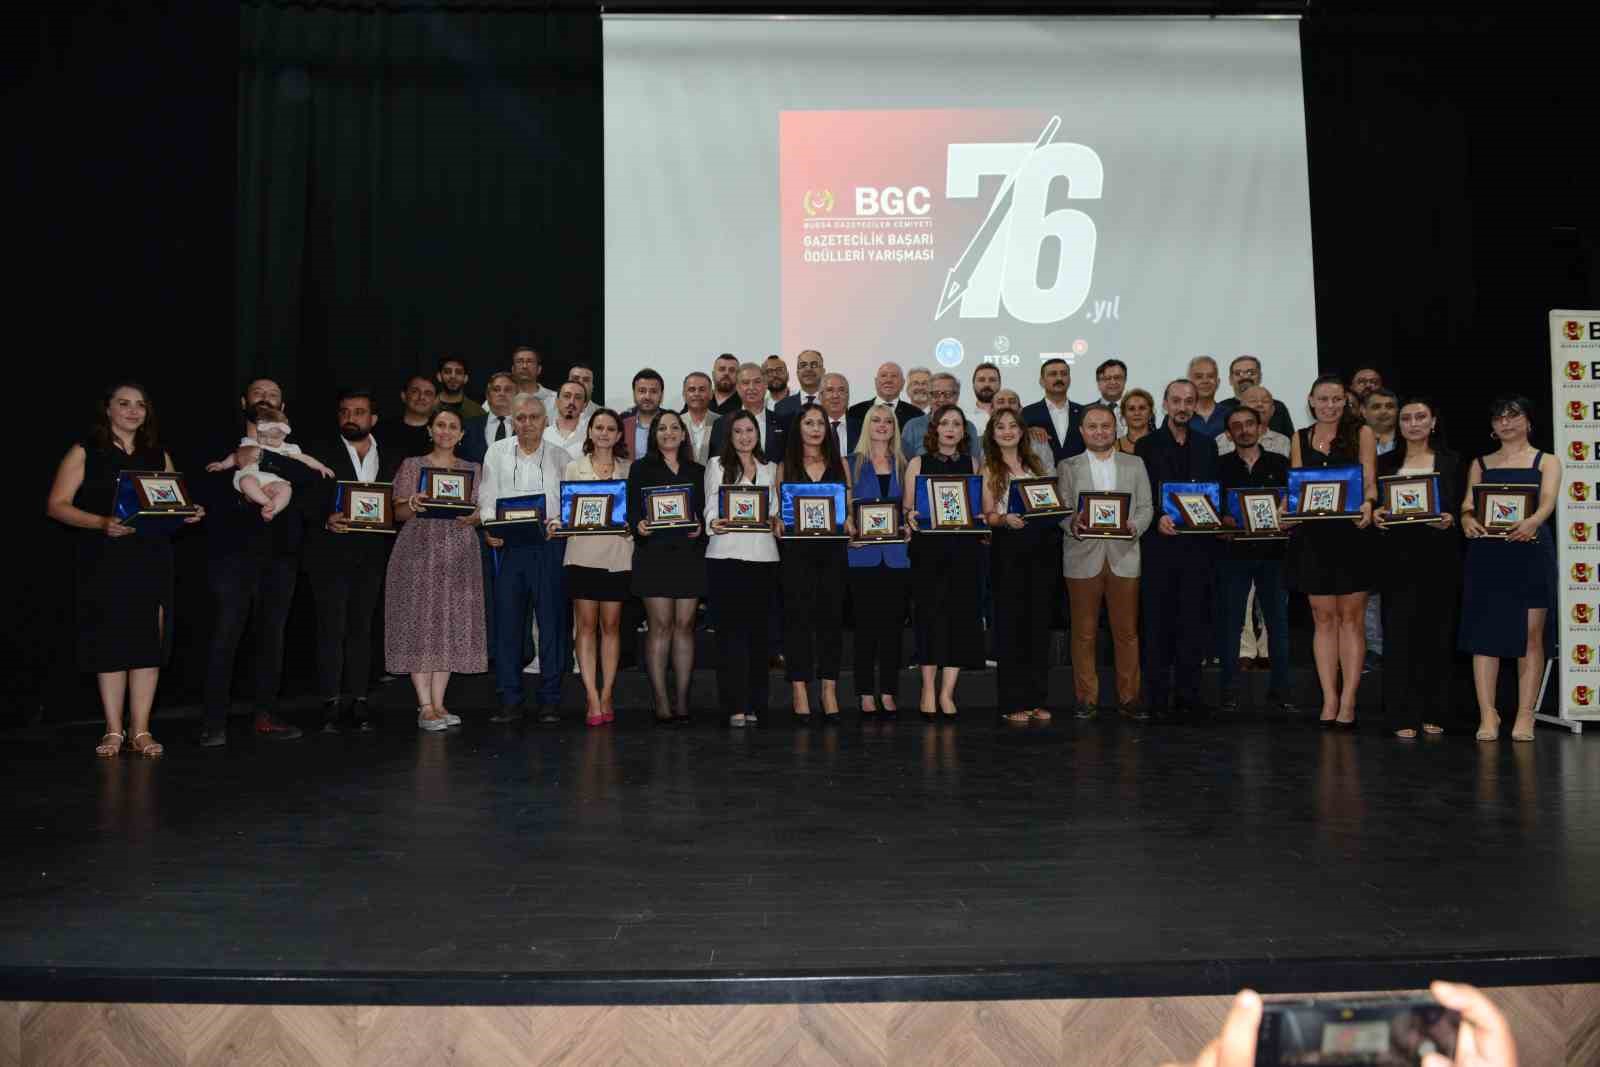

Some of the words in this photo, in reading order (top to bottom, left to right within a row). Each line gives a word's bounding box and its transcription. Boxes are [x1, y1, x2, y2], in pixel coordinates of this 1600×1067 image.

[855, 186, 931, 216] BGC
[803, 231, 885, 247] GAZETECİLİK
[946, 142, 1103, 323] 76
[804, 247, 865, 262] ÖDÜLLERİ
[867, 248, 934, 263] YARIŞMASI
